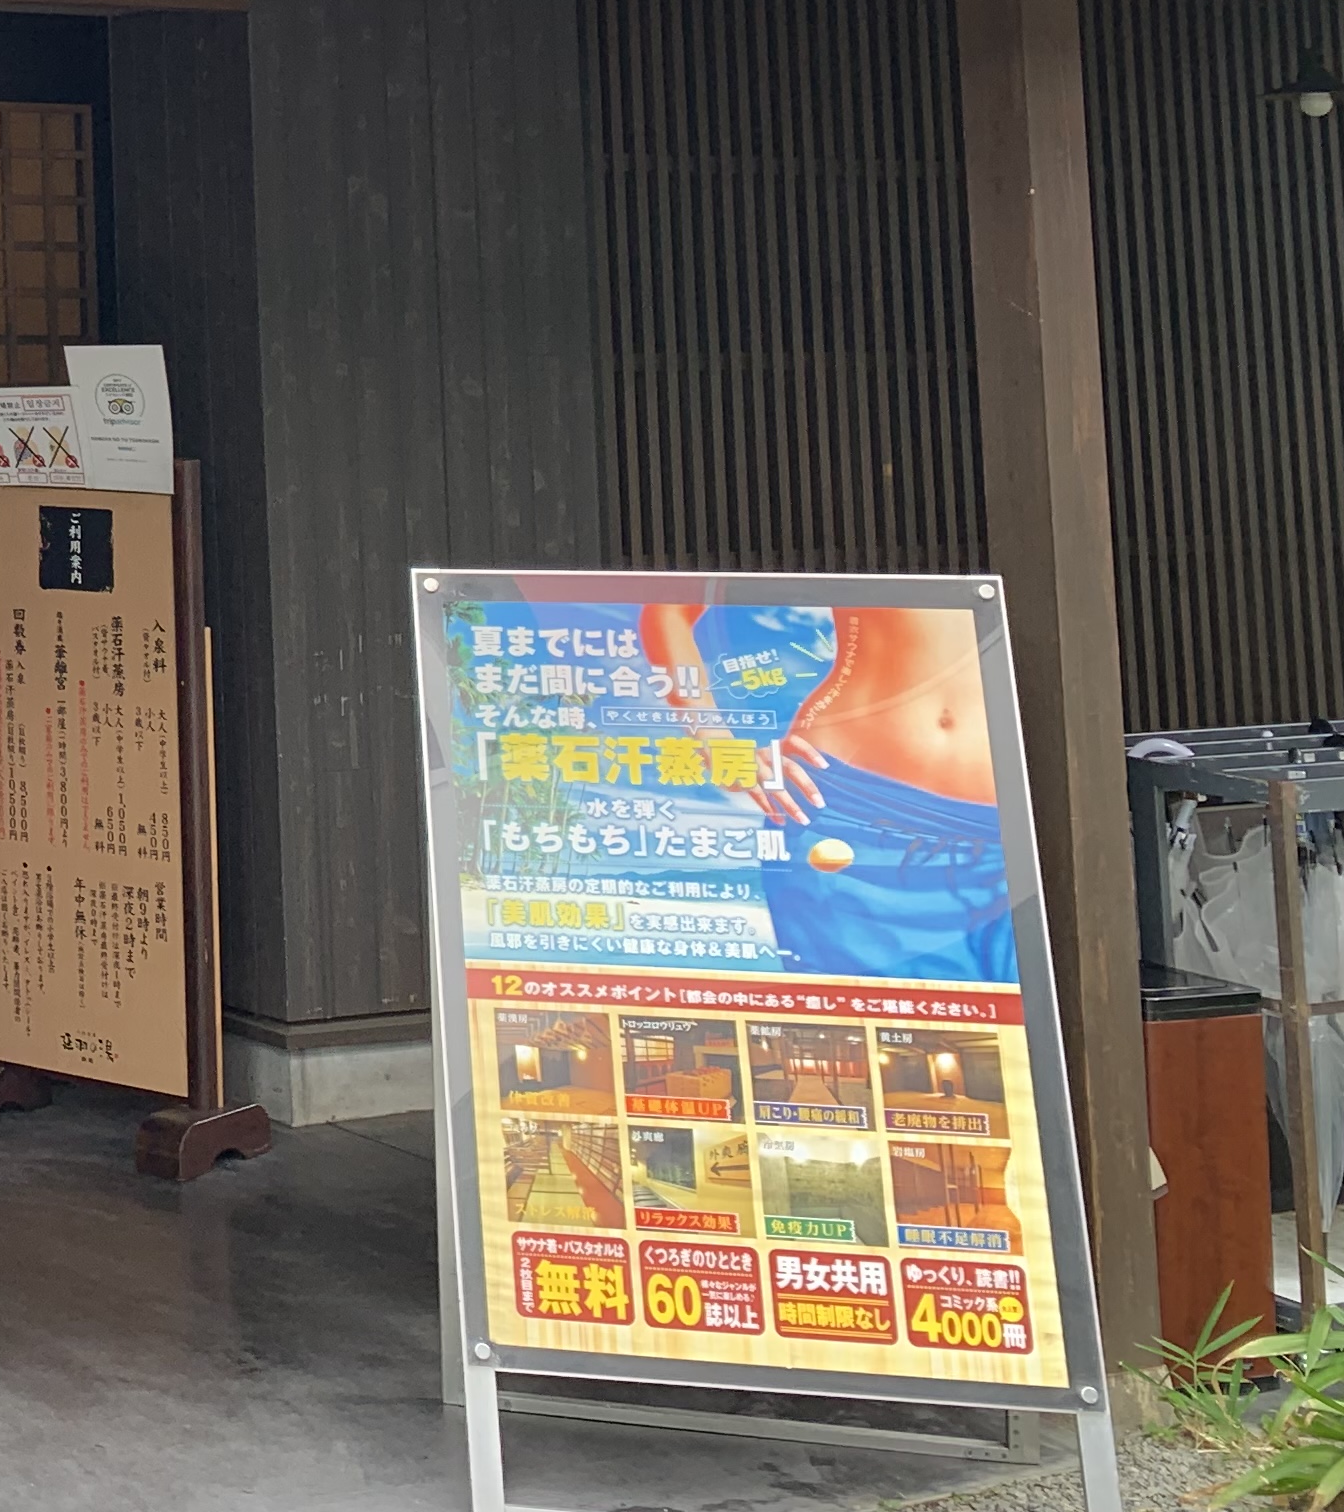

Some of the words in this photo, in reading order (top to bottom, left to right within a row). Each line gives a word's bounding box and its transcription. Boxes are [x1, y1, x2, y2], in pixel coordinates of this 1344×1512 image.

[68, 512, 82, 584] ご利用案内
[471, 625, 640, 658] 夏までには
[722, 648, 780, 674] 目指せ!
[474, 664, 701, 699] まだ間に合う!!
[475, 704, 598, 730] そんな時、
[606, 709, 771, 726] やくせきはんじゅんぼう
[476, 731, 786, 792] 「薬石汗蒸房」
[586, 798, 676, 820] 水を弾く
[481, 819, 792, 862] 「もちもち」たまご肌
[891, 1112, 983, 1131] 老廃物を排出
[639, 1212, 733, 1231] リラックス効果
[770, 1219, 847, 1238] 免疫力UP
[644, 1248, 753, 1272] くつろぎのひととき
[775, 1255, 889, 1296] 男女共用
[906, 1264, 1021, 1291] ゆっくり、読書!!
[535, 1259, 630, 1320] 無料
[647, 1273, 702, 1326] 60
[940, 1294, 1000, 1312] コミック系
[704, 1303, 760, 1330] 誌以上
[778, 1301, 891, 1331] 時間制限なし
